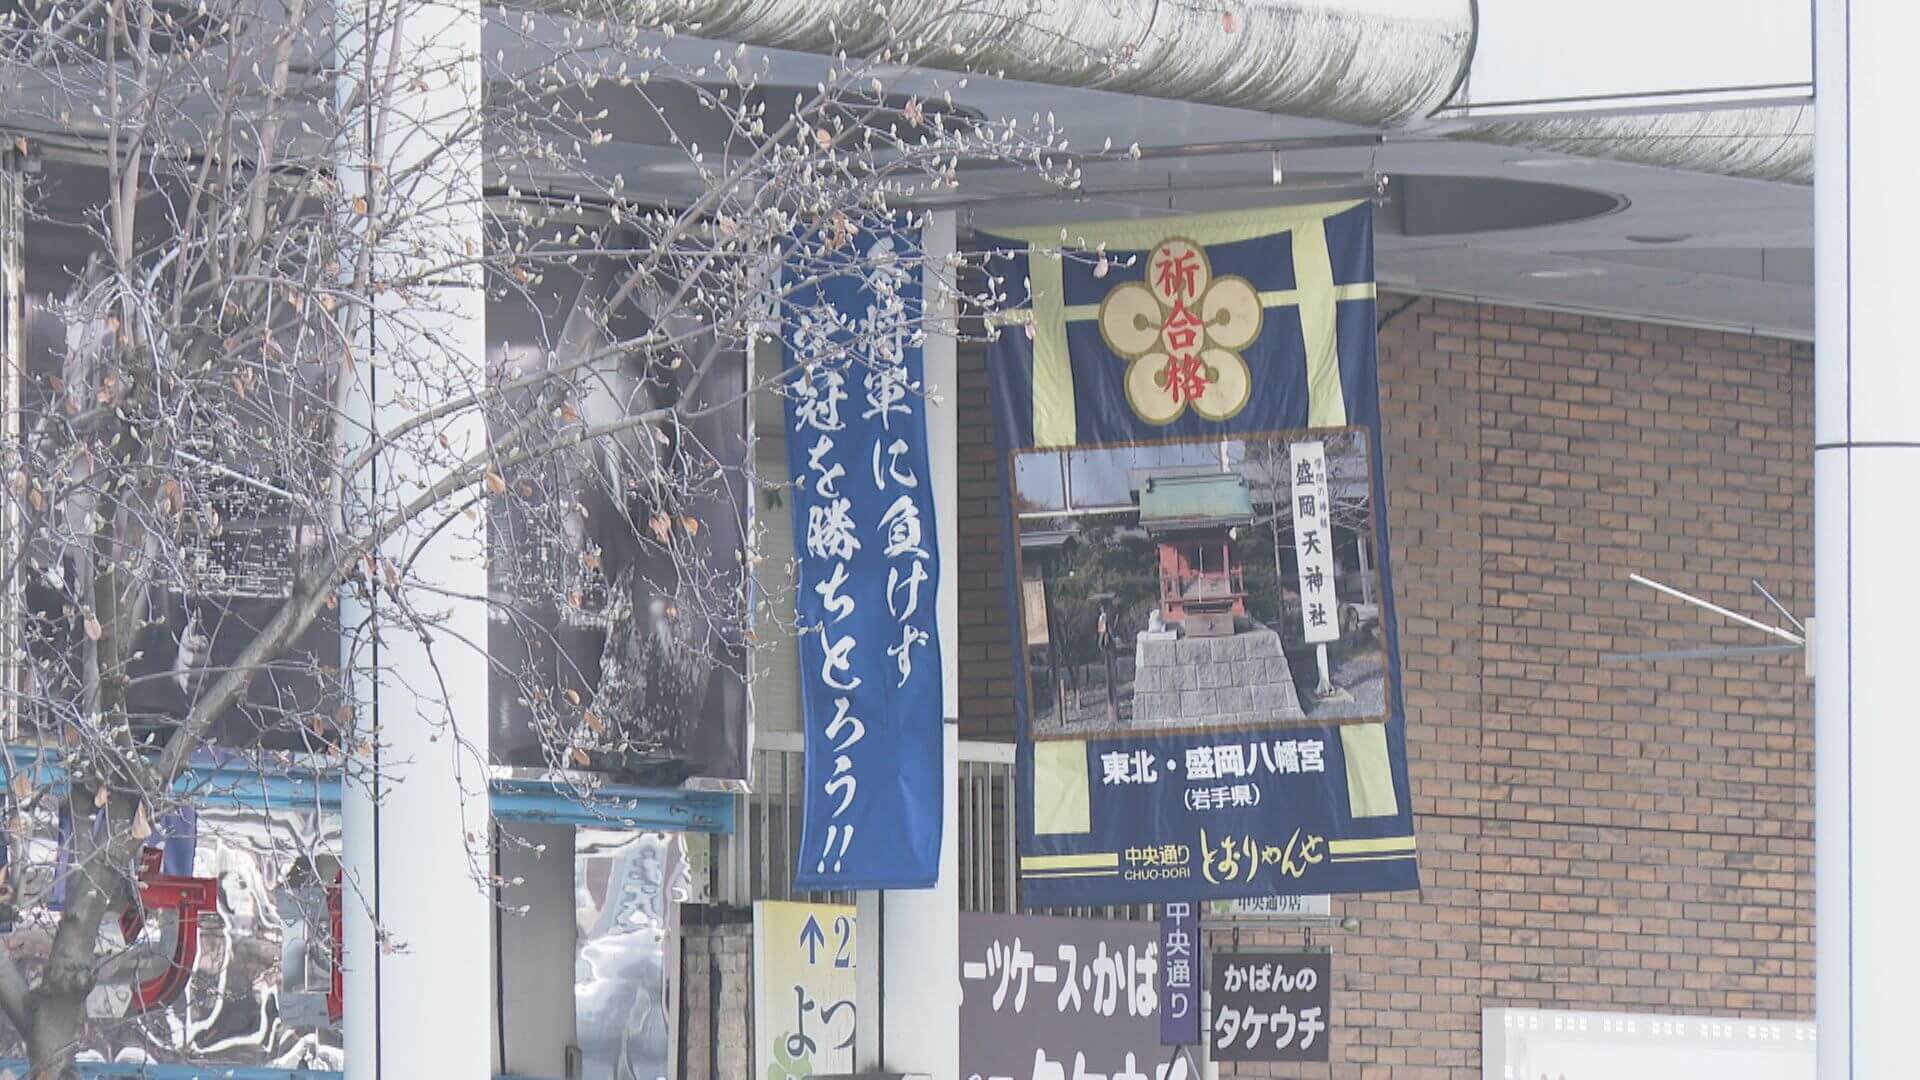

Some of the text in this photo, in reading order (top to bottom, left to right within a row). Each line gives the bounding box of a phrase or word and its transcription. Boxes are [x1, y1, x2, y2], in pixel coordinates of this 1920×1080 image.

[1155, 248, 1207, 402] 祈合格
[1296, 458, 1328, 627] 盛岡天神社
[1101, 740, 1325, 785] 東北・盛岡八幡宮
[1184, 783, 1261, 811] (岩手県)
[1124, 866, 1190, 881] CHUO-DORI
[1125, 845, 1190, 867] 中央通り
[834, 914, 856, 968] 2
[1166, 903, 1191, 1019] 中央通り
[957, 936, 1161, 1017] ーツケース・かば
[1224, 963, 1317, 993] かばんの
[1215, 1004, 1325, 1050] タケウチ
